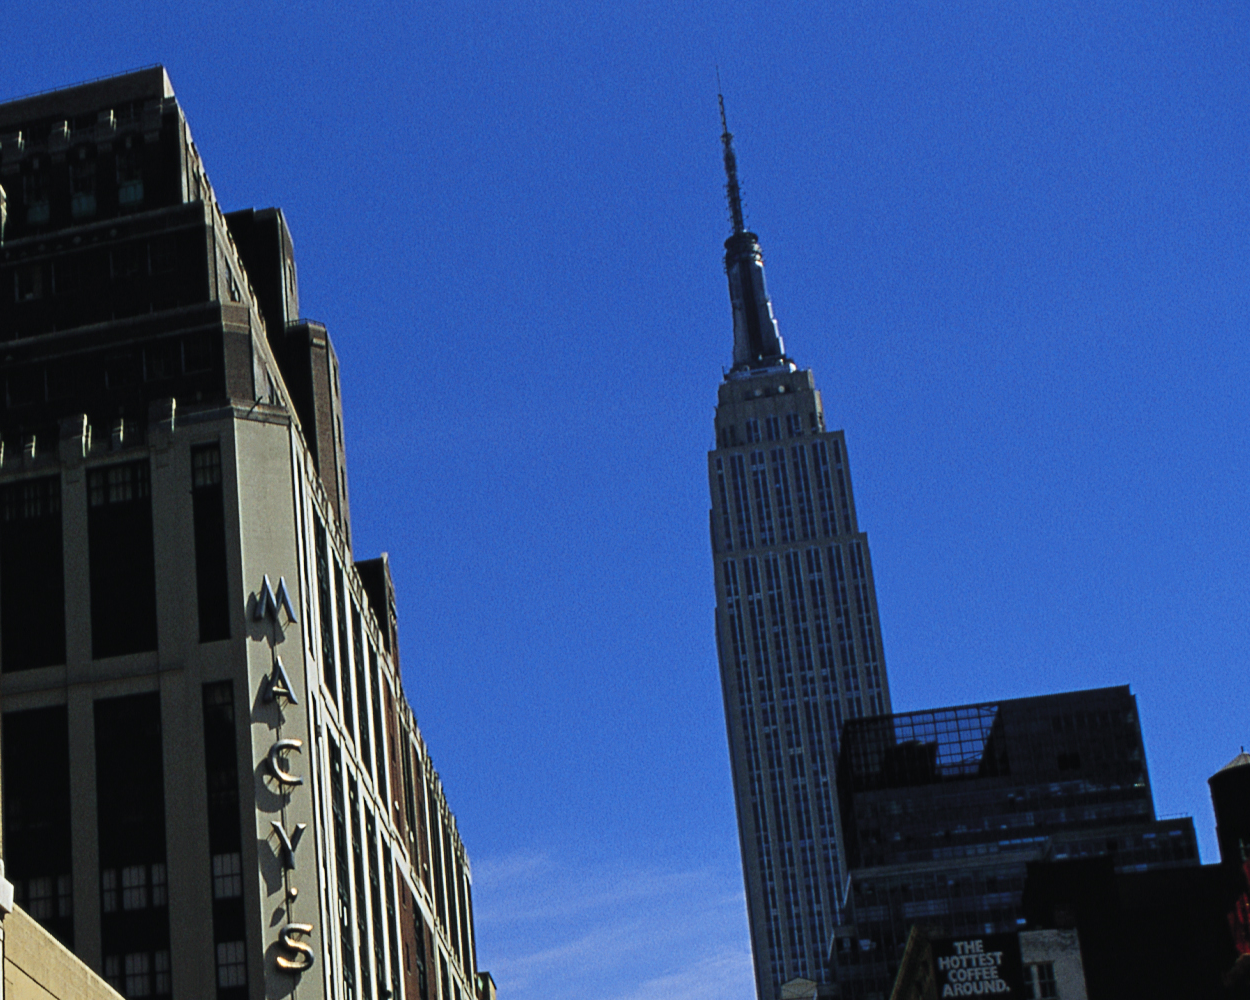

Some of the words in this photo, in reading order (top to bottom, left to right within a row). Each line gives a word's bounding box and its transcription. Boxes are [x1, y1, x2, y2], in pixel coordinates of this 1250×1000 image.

[953, 939, 985, 955] THE
[938, 951, 1004, 971] HOTTEST
[947, 966, 999, 983] COFFEE
[942, 979, 1011, 999] AROUND.
